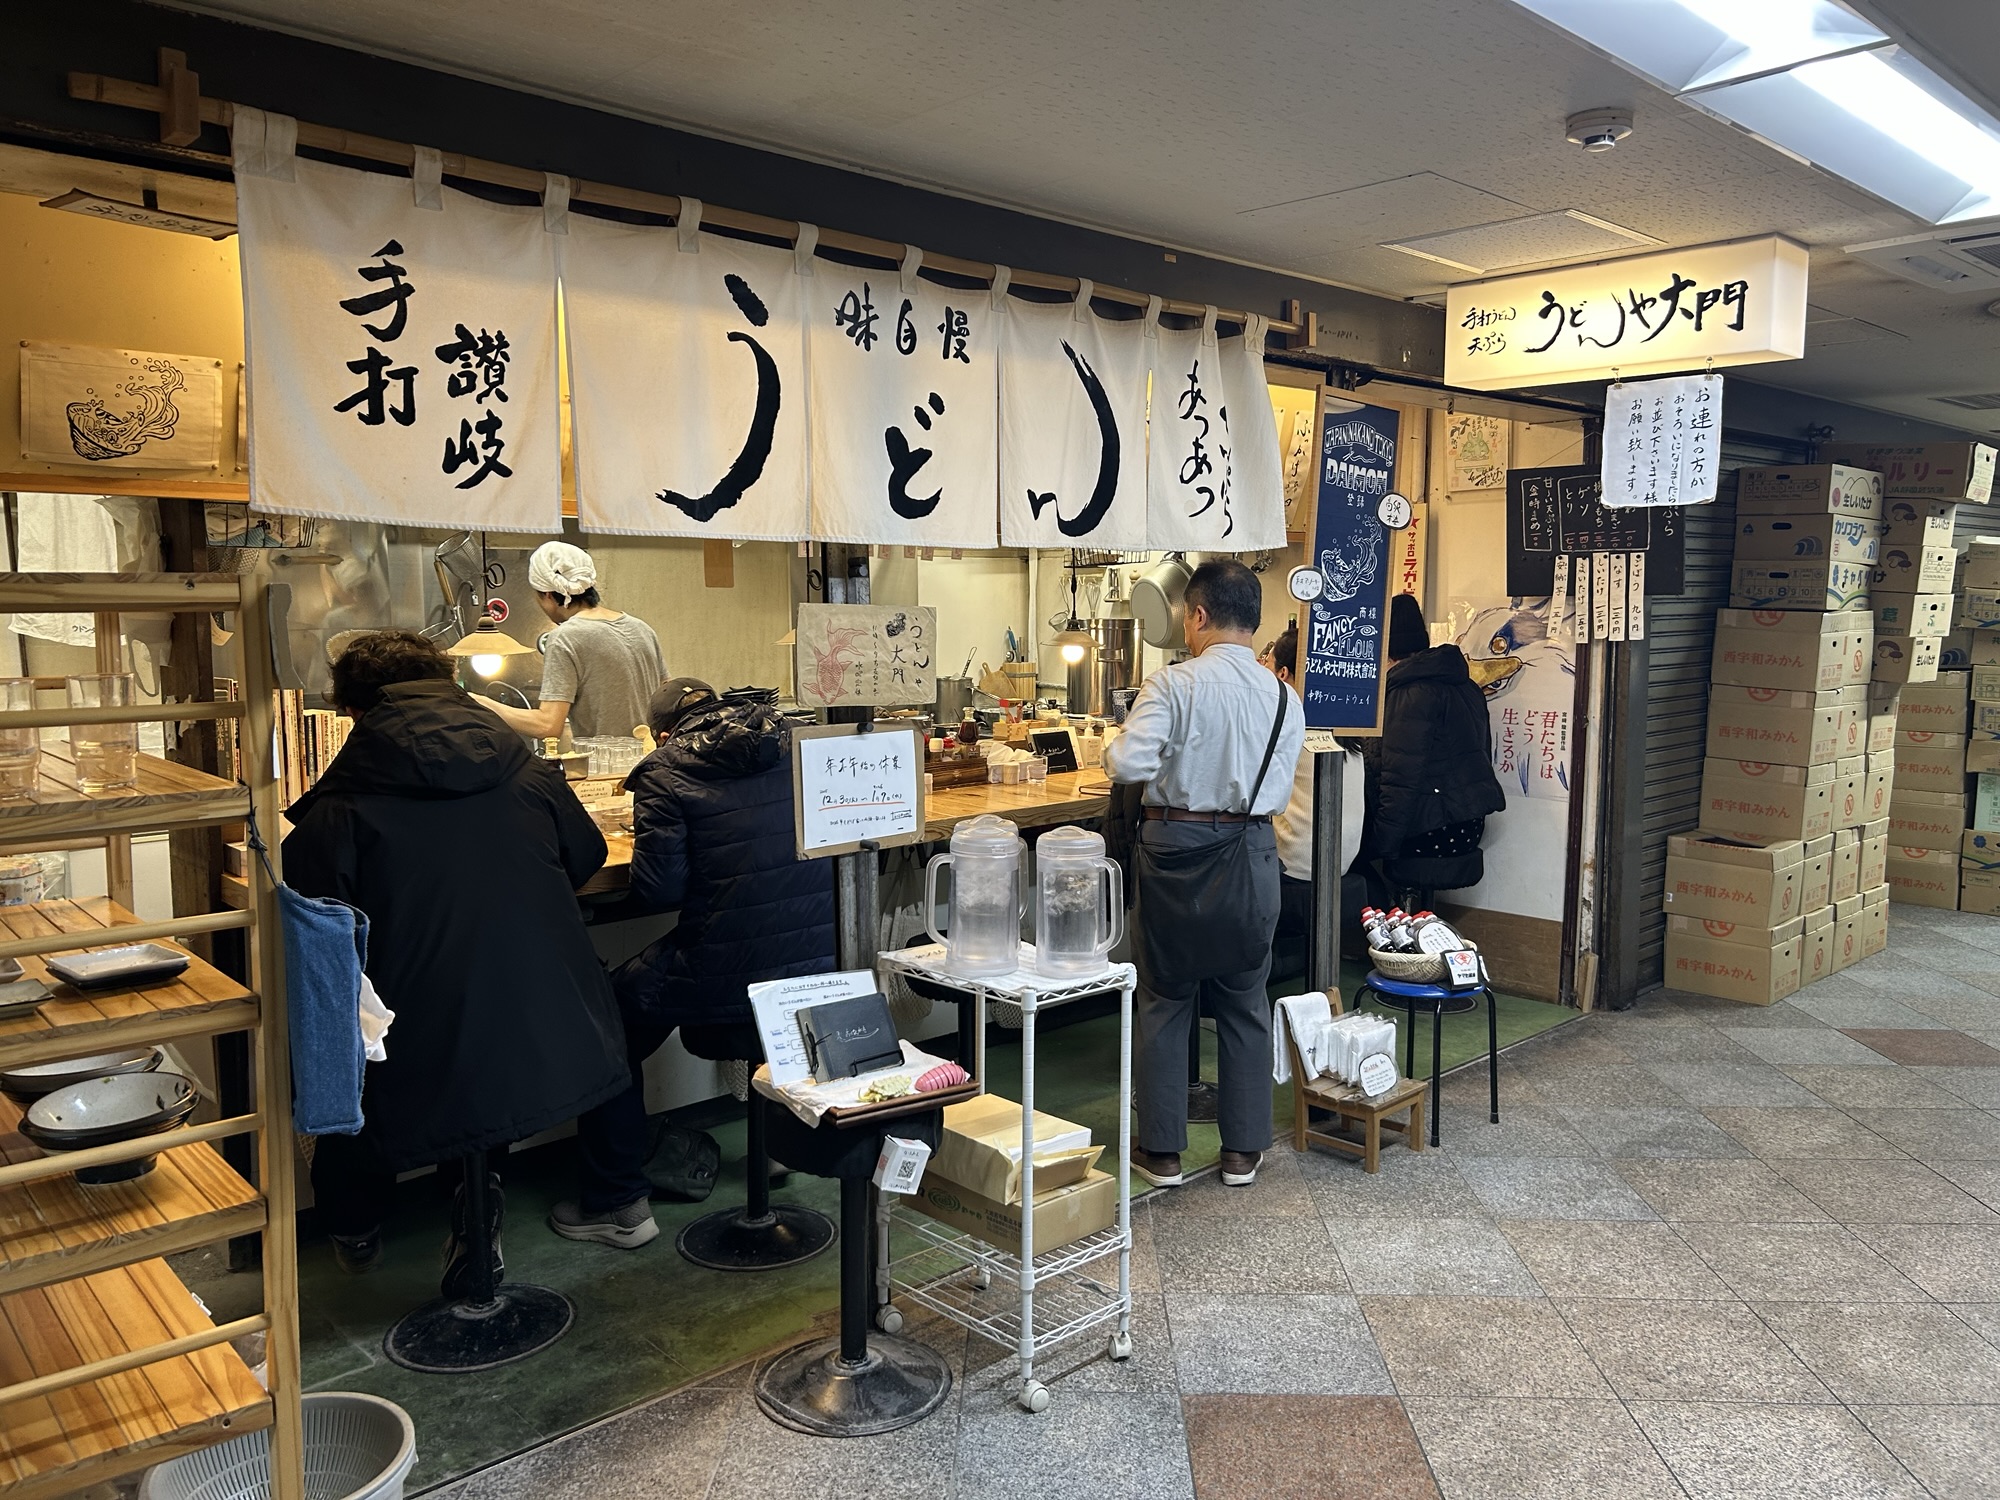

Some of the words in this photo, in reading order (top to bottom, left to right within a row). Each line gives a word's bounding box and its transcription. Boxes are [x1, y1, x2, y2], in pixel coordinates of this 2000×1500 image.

[834, 281, 970, 364] 味自慢
[1461, 306, 1516, 330] 手打うどん
[1523, 273, 1748, 354] うどんや大門
[333, 239, 419, 427] 手打
[1467, 330, 1507, 357] 天ぷら
[655, 273, 1121, 538] うどん
[1178, 359, 1215, 518] あつあつ
[1326, 426, 1348, 448] JAPAN
[1348, 422, 1375, 448] NAKANO
[1375, 434, 1394, 460] TOKYO
[1625, 398, 1643, 500] お願い致します。
[1644, 395, 1665, 505] お並び下さいます様
[1667, 392, 1686, 504] おそろいになりましたら
[1689, 386, 1715, 489] お連れの方が
[1325, 458, 1388, 495] DAIMON
[1528, 484, 1541, 531] 金時まめ
[1565, 488, 1574, 515] とり
[1578, 486, 1590, 517] ゲソ
[1843, 493, 1872, 510] 生しいたけ
[1407, 531, 1416, 557] サッポロ
[1834, 520, 1867, 542] カリフラワー
[1578, 562, 1586, 605] まいたけ
[1596, 558, 1605, 596] しいたけ
[1613, 565, 1623, 589] なす
[1632, 559, 1643, 592] ごぼう
[1778, 587, 1787, 597] 8
[1313, 616, 1358, 651] FANCY
[1338, 629, 1375, 659] FLOUR
[890, 644, 907, 684] 大門
[1723, 650, 1804, 669] 西宇和みかん
[1307, 689, 1371, 705] 中野ブロードウェイ
[1498, 708, 1520, 774] 生きるか
[1523, 709, 1539, 746] どう
[1718, 725, 1799, 744] 西宇和みかん
[1540, 711, 1559, 780] 君たちは
[825, 754, 902, 778] 年末年始の休業
[1711, 798, 1790, 819] 西宇和みかん
[1676, 881, 1757, 905] 西宇和みかん
[1676, 958, 1757, 982] 西宇和みかん
